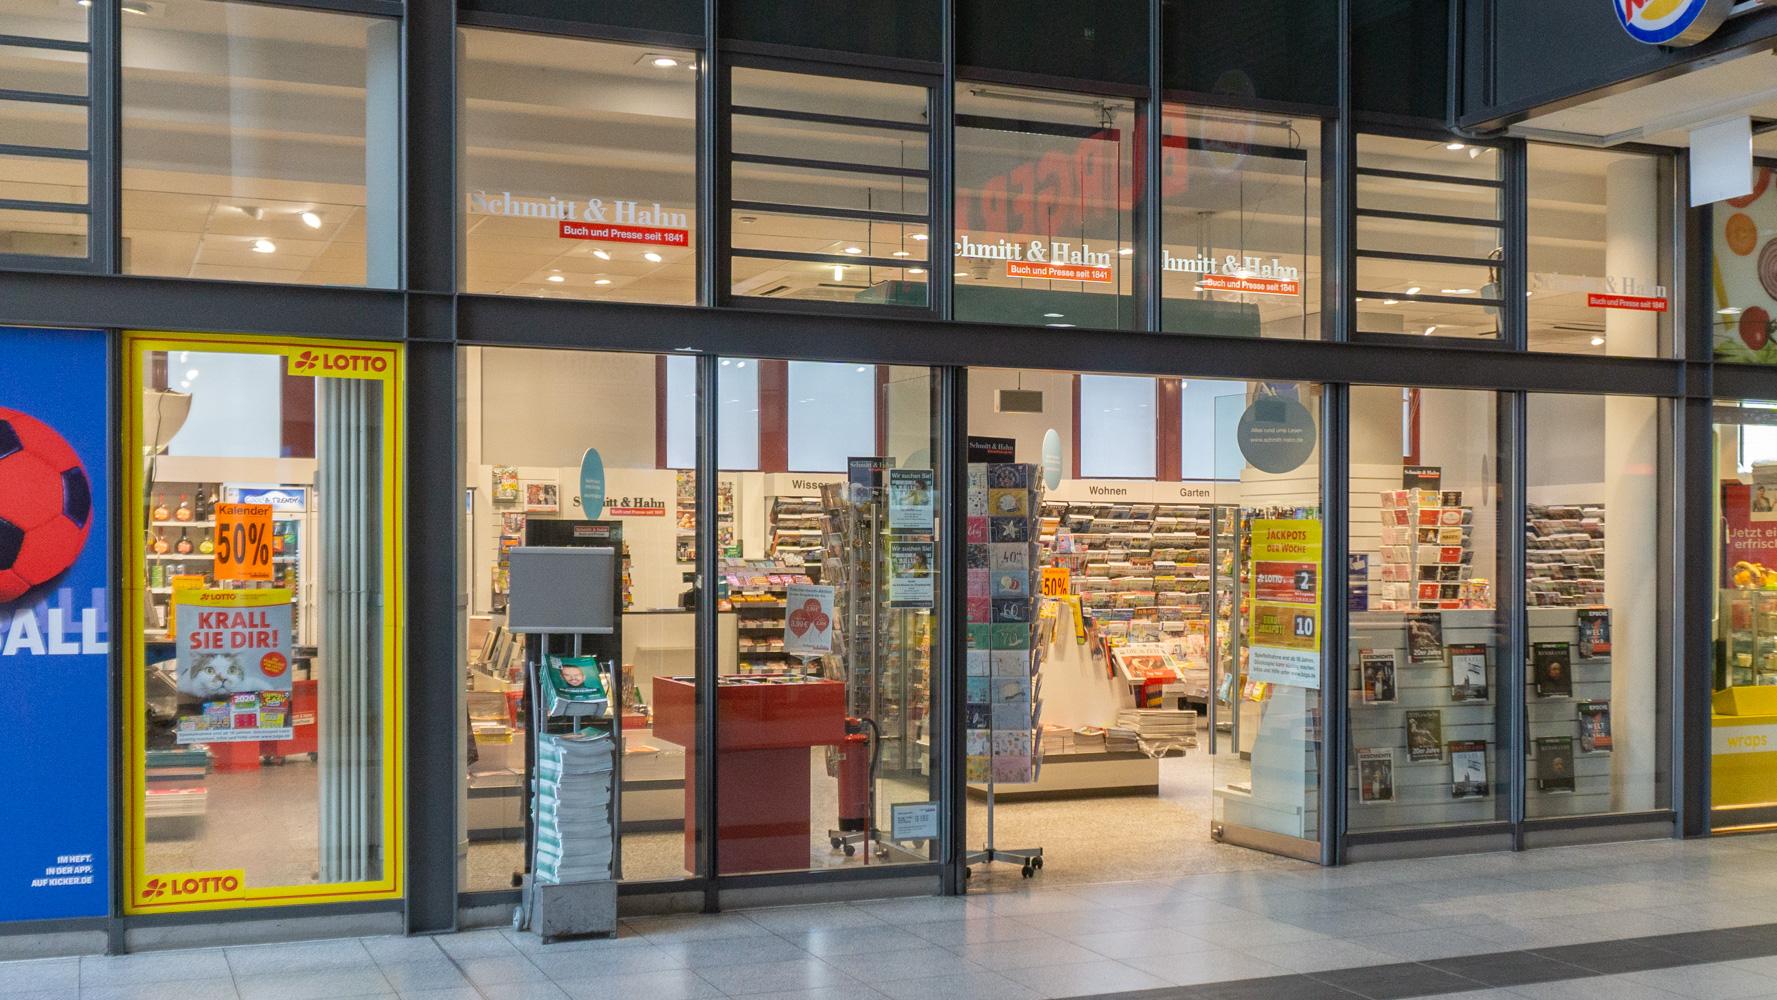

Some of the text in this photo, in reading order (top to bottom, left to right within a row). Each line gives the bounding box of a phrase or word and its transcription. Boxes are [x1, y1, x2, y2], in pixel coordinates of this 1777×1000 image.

[471, 190, 689, 228] Schmitt & Hahn
[564, 225, 684, 242] Buch und Presse seit 1841
[954, 235, 1111, 268] chmitt & Hahn
[1011, 265, 1107, 279] Buch und Presse seit 1841
[1162, 250, 1298, 280] hmitt & Hahn
[1207, 278, 1295, 292] Buch und Presse seit 1841
[1607, 298, 1619, 306] und
[1620, 299, 1639, 307] Presse
[323, 354, 387, 372] LOTTO
[1089, 486, 1127, 495] Wohnen
[1180, 488, 1210, 497] Garten
[573, 496, 665, 508] Sitt & Hahn
[219, 505, 269, 516] Kalender
[1266, 528, 1307, 540] JACKPOTS
[1730, 527, 1761, 538] Jetzt
[218, 522, 269, 566] 50%
[1044, 577, 1067, 596] 50%
[1300, 571, 1309, 590] 2
[198, 611, 270, 629] KRALL
[1296, 617, 1313, 636] 10
[2, 608, 109, 655] ALL
[190, 629, 279, 649] SIE DIR!
[1728, 735, 1768, 749] wraps
[57, 854, 92, 864] IM HEFT.
[45, 865, 92, 875] IN DER APP.
[31, 876, 93, 887] AUF KICKER.DE
[171, 875, 238, 895] LOTTO
